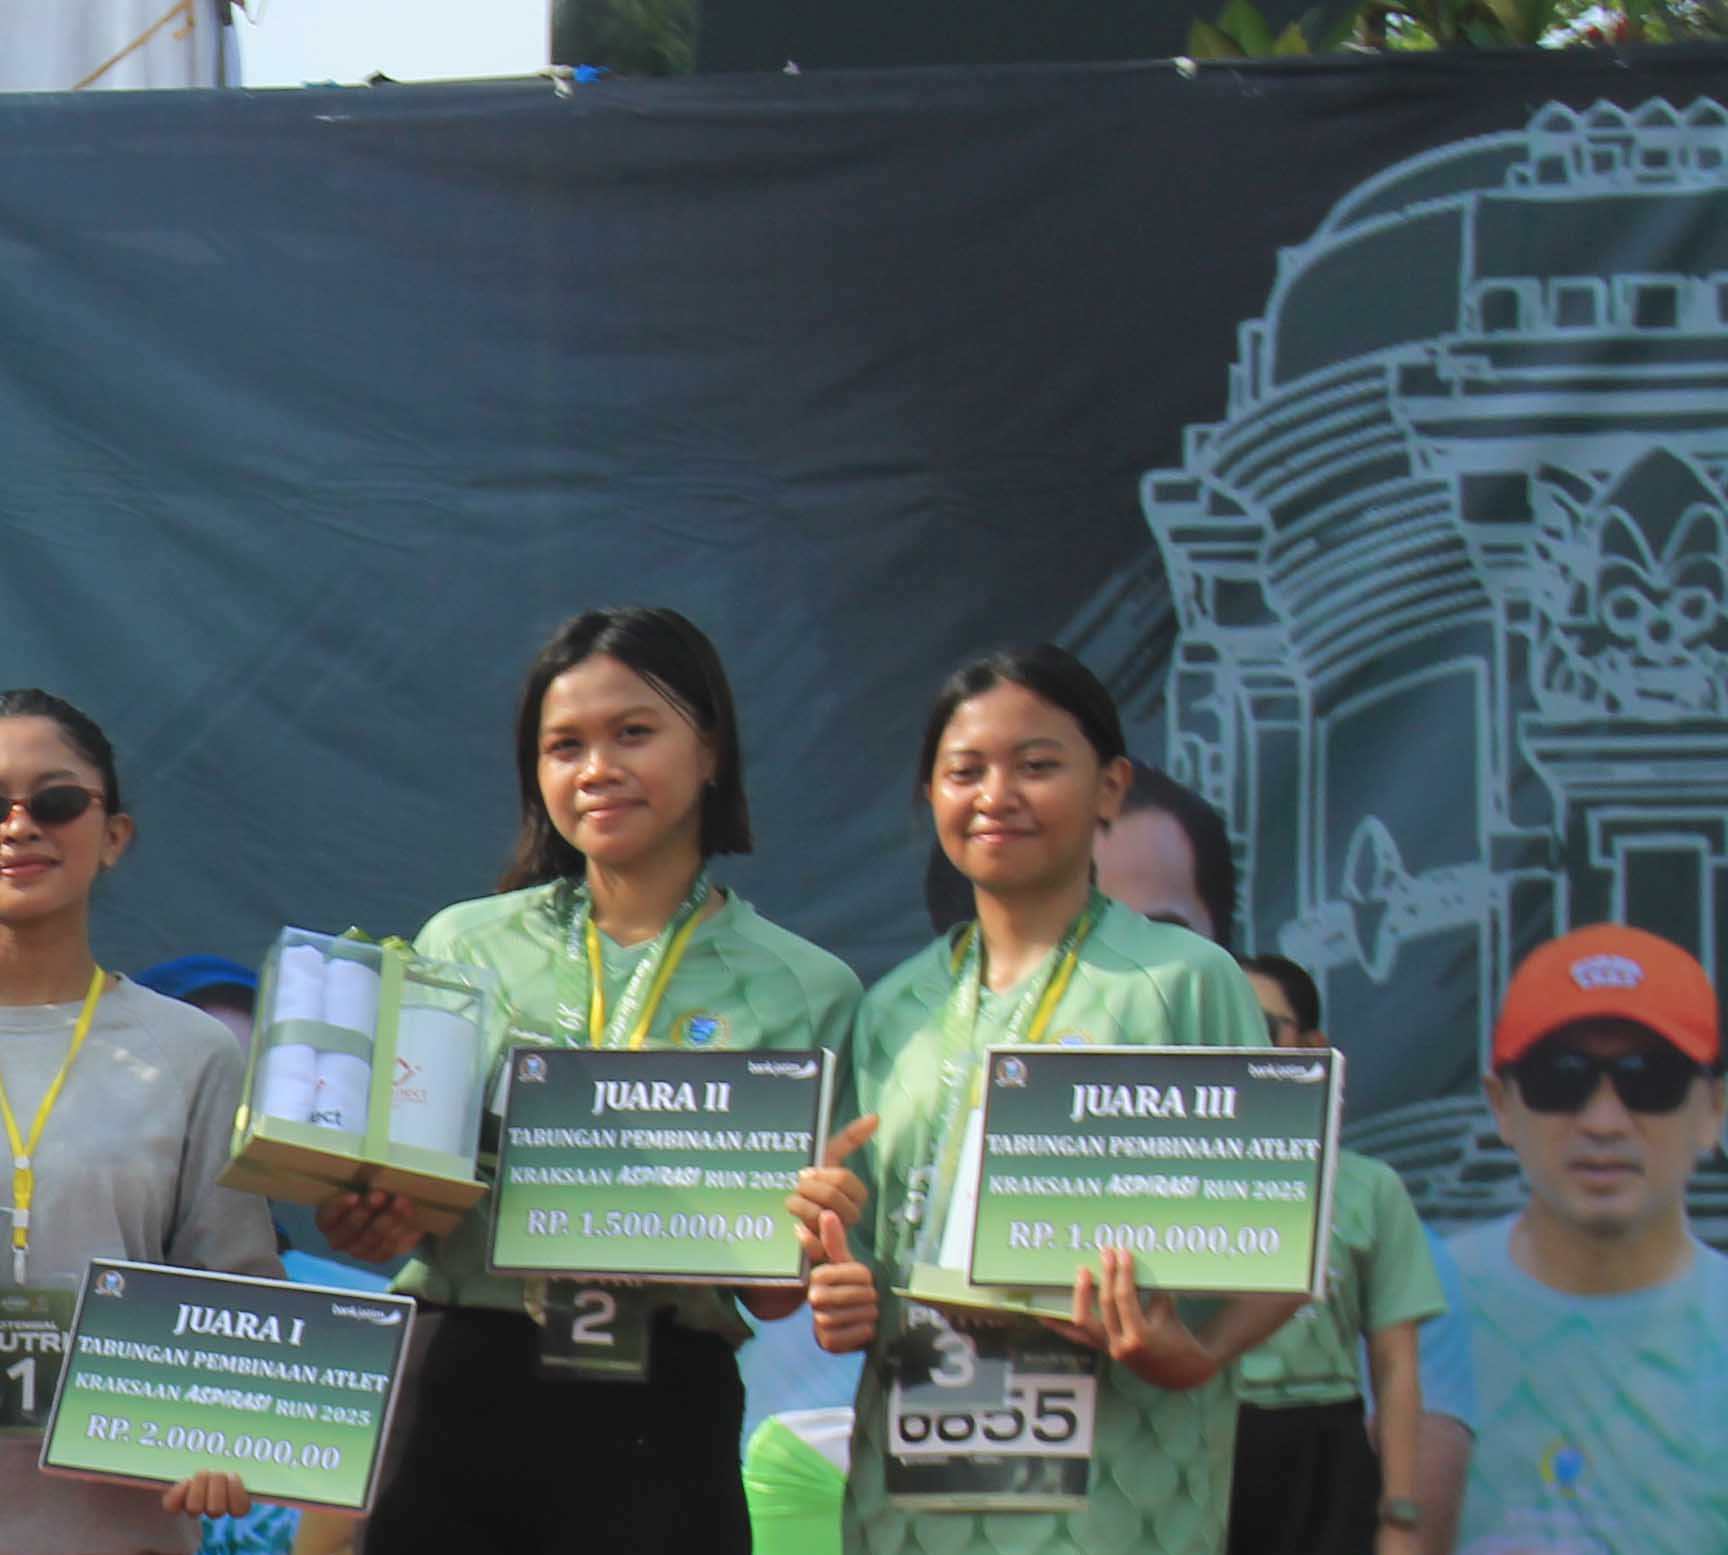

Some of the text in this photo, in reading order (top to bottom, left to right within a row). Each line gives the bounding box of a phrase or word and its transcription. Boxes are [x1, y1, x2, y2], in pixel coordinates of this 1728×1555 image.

[592, 1080, 731, 1116] JUARA II
[1070, 1084, 1237, 1122] JUARA III
[508, 1127, 812, 1152] TABUNGAN PEMBINAAN ATLET
[986, 1133, 1320, 1160] TABUNGAN PEMBINAAN ATLET
[510, 1166, 612, 1186] KRAKSAAN
[705, 1170, 747, 1189] RUN
[750, 1171, 799, 1190] 2025
[989, 1175, 1104, 1196] KRAKSAAN
[1203, 1178, 1249, 1199] RUN
[1252, 1180, 1307, 1200] 2025
[527, 1208, 775, 1244] RP. 1.500.000,00
[1009, 1221, 1280, 1258] RP. 1.000.000,00
[173, 1303, 305, 1346] JUARA I
[572, 1290, 616, 1345] 2
[78, 1336, 390, 1394] TABUNGAN PEMBINAAN ATLET
[931, 1332, 978, 1388] 3
[7, 1356, 37, 1412] 1
[75, 1372, 181, 1401] KRAKSAAN
[275, 1398, 317, 1420] RUN
[321, 1406, 372, 1426] 2025
[86, 1414, 342, 1471] RP. 2.000.000,00
